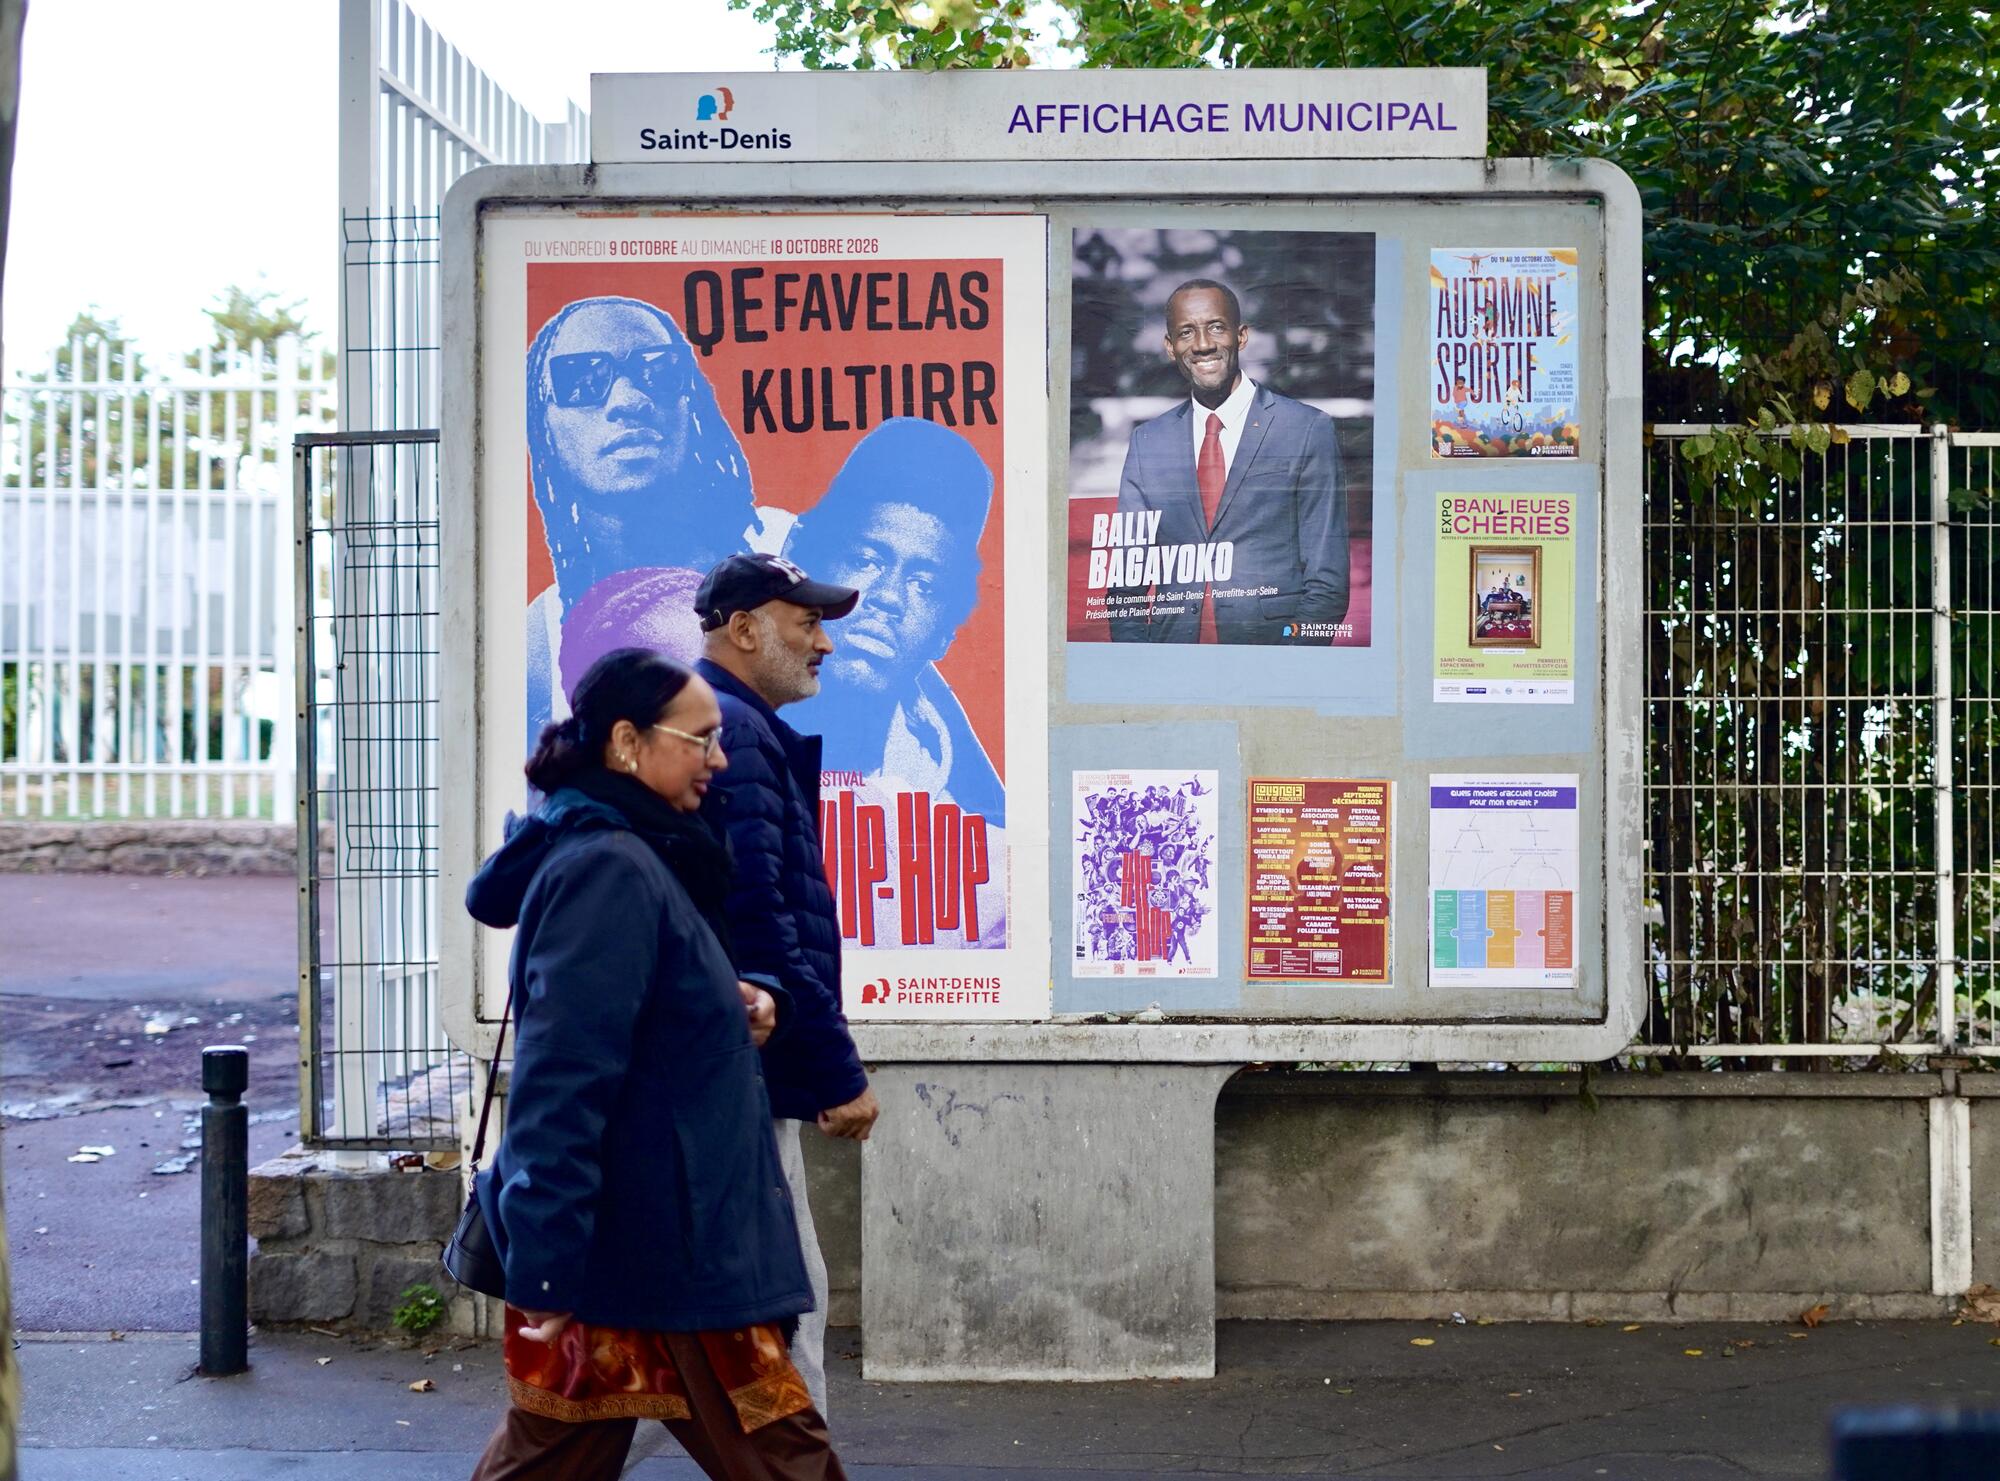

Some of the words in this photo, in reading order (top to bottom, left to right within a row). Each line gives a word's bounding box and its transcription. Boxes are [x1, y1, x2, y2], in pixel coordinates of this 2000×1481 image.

[1007, 102, 1229, 134] AFFICHAGE
[1243, 101, 1458, 132] MUNICIPAL
[639, 128, 792, 150] Saint-Denis
[524, 240, 542, 257] DU
[544, 240, 606, 257] VENDREDI
[609, 240, 617, 255] 9
[620, 240, 678, 255] OCTOBRE
[681, 240, 698, 256] AU
[701, 239, 767, 255] DIMANCHE
[771, 239, 782, 254] 18
[786, 239, 843, 254] OCTOBRE
[847, 238, 879, 254] 2026
[1437, 277, 1558, 339] AUTOMNE
[1437, 342, 1537, 404] SPORTIF
[1441, 498, 1453, 534] EXPO
[1454, 498, 1570, 514] BANLIEUES
[1091, 509, 1162, 547] BALLY
[1453, 511, 1570, 535] CHÉRIES
[1087, 541, 1234, 589] BAGAYOKO
[1086, 597, 1105, 606] Maire
[1106, 596, 1114, 604] de
[1116, 596, 1122, 604] la
[1123, 594, 1155, 604] commune
[1156, 593, 1165, 602] de
[1166, 590, 1204, 601] Saint-Denis
[1211, 586, 1278, 598] Pierrefitte-sur-Seine
[1085, 609, 1118, 619] Président
[1118, 609, 1127, 617] de
[1128, 607, 1150, 617] Plaine
[1151, 606, 1185, 615] Commune
[1473, 789, 1498, 797] modes
[897, 977, 1001, 989] SAINT-DENIS
[897, 992, 1000, 1004] PIERREFITTE
